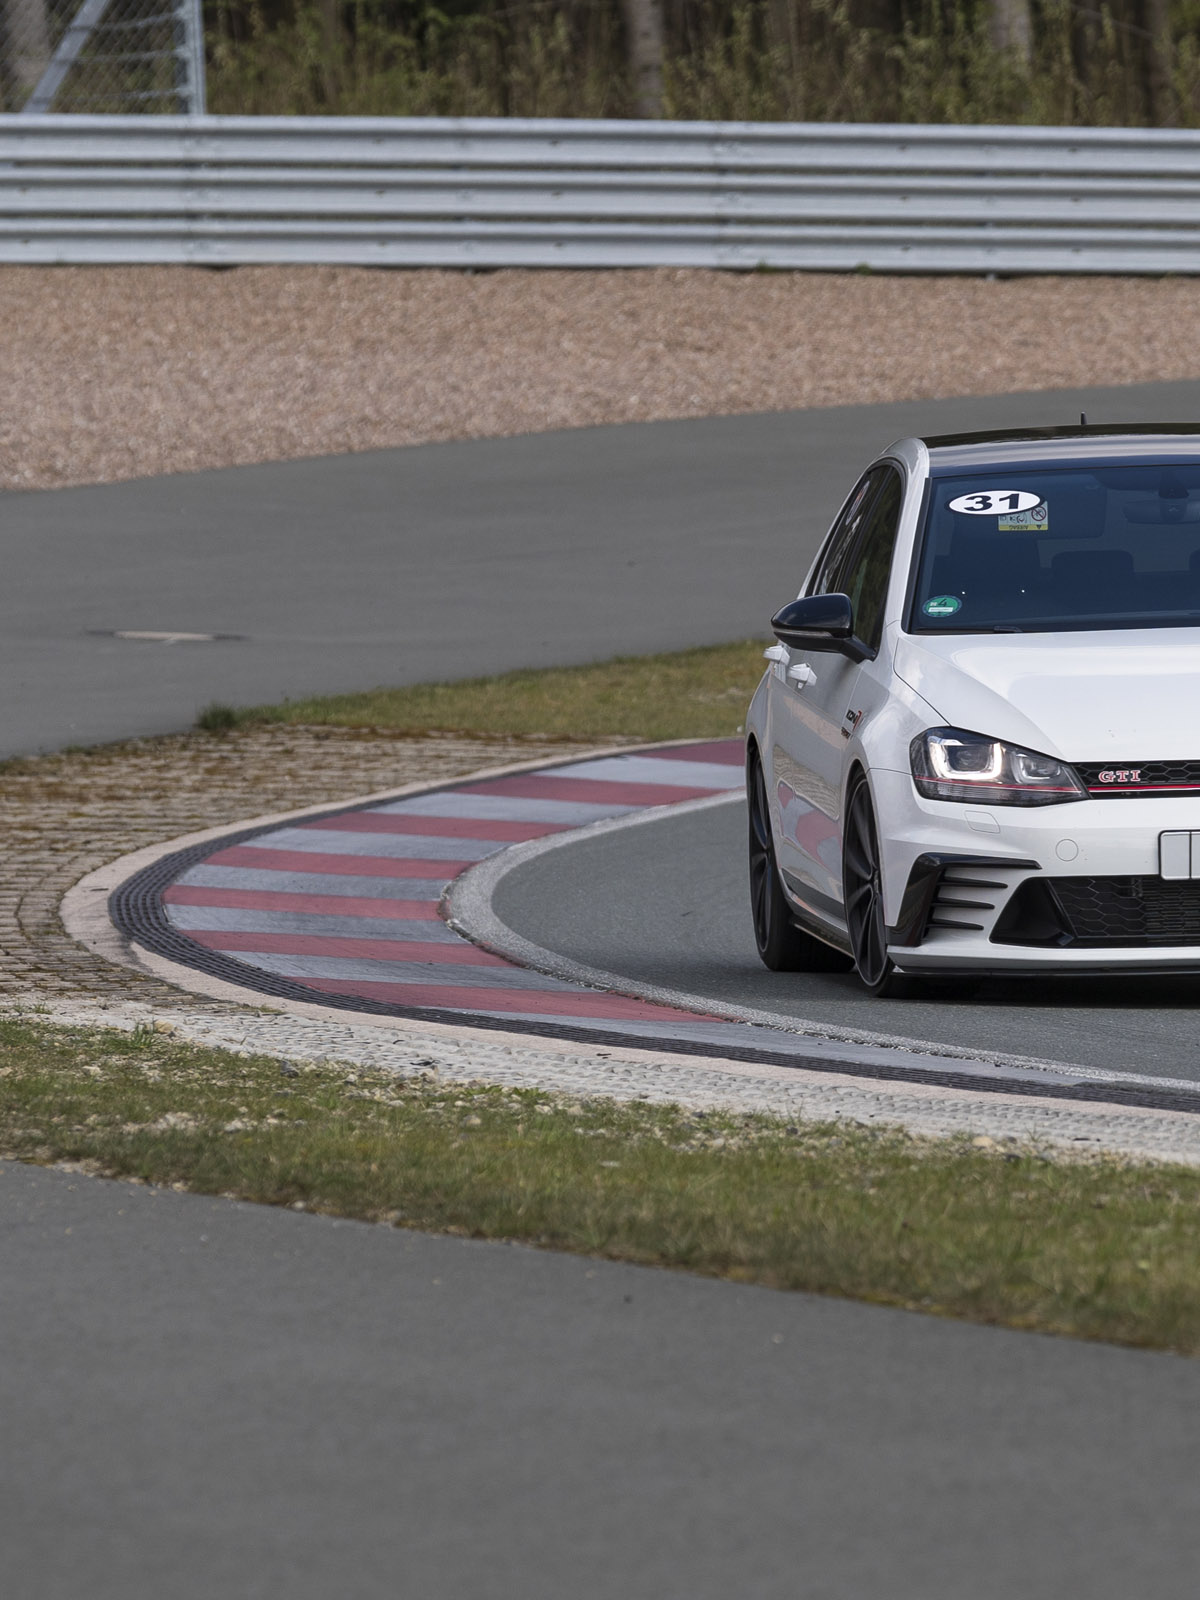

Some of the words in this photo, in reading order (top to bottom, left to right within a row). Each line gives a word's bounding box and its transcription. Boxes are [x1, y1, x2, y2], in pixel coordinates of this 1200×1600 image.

[964, 493, 1020, 512] 31
[937, 598, 948, 607] 4
[1098, 770, 1141, 783] GTI
